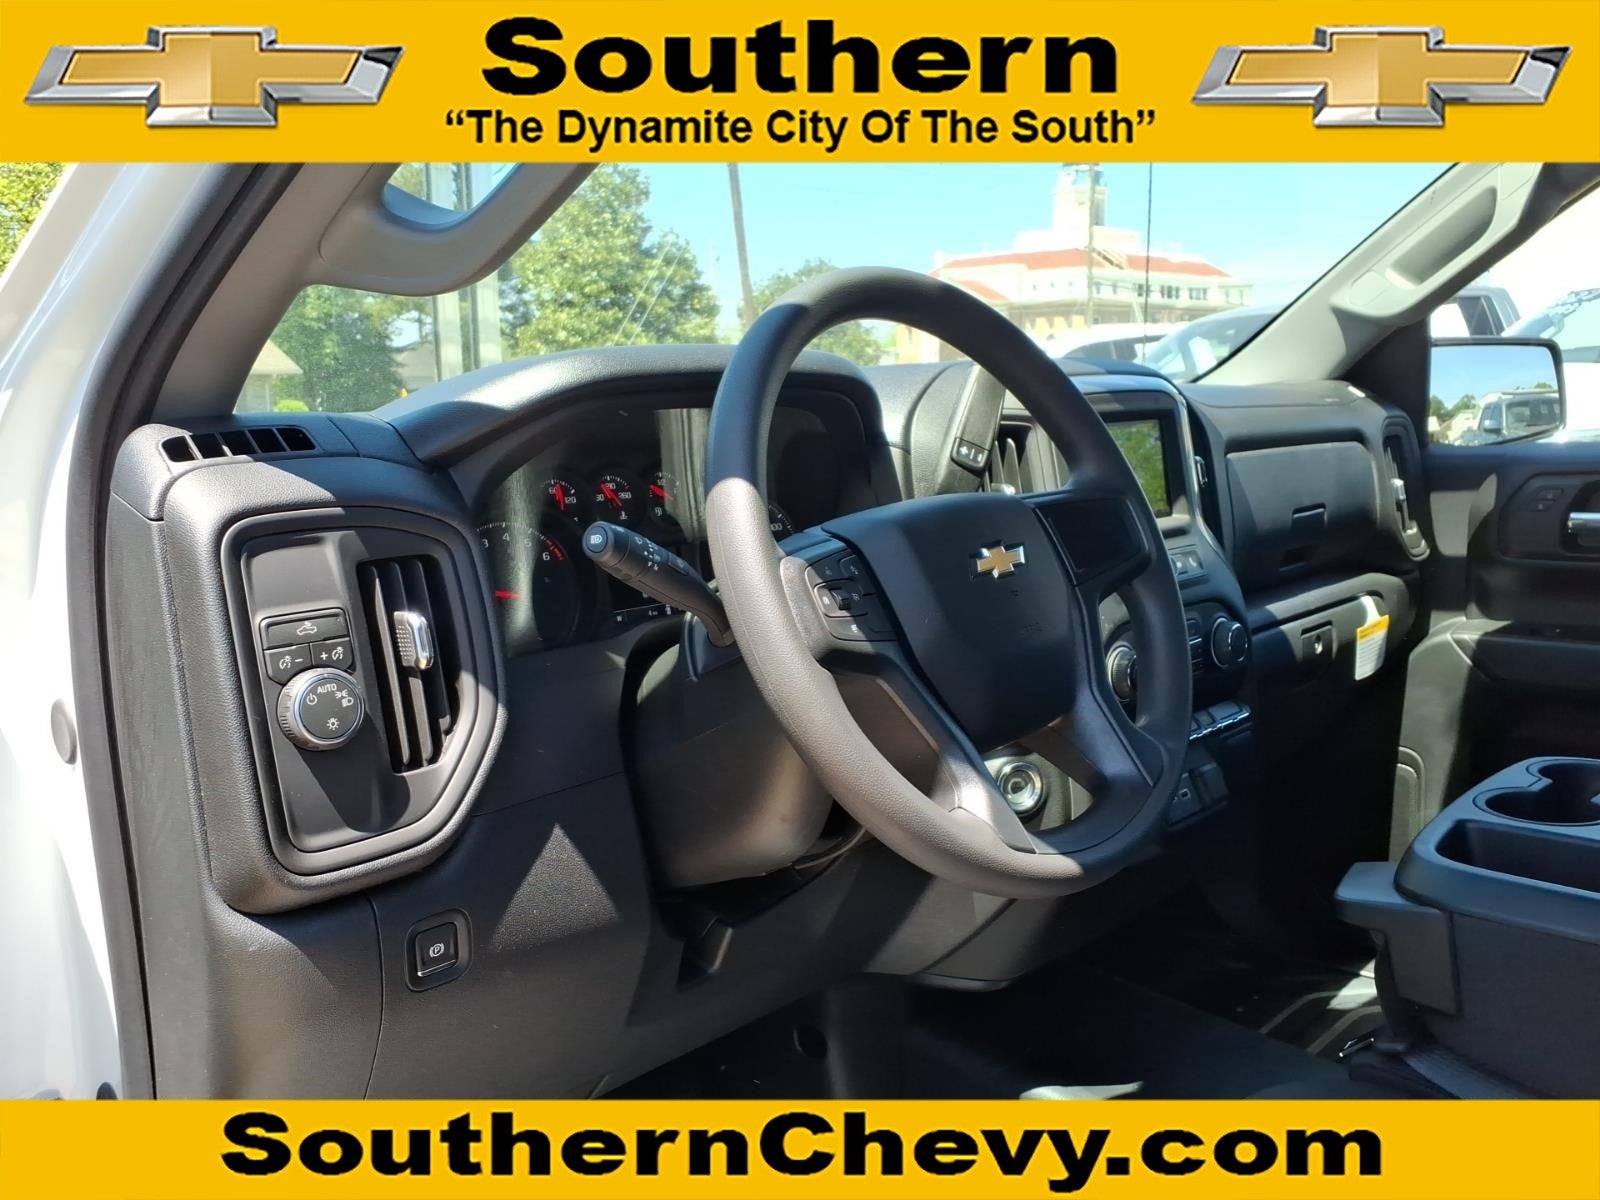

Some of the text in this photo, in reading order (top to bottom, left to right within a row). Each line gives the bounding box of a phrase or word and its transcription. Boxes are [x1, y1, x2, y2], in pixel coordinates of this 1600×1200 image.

[770, 522, 783, 531] 00
[502, 532, 510, 541] 4
[481, 538, 489, 548] 3
[524, 538, 532, 547] 5
[542, 551, 551, 561] 6
[317, 683, 337, 694] AUTO
